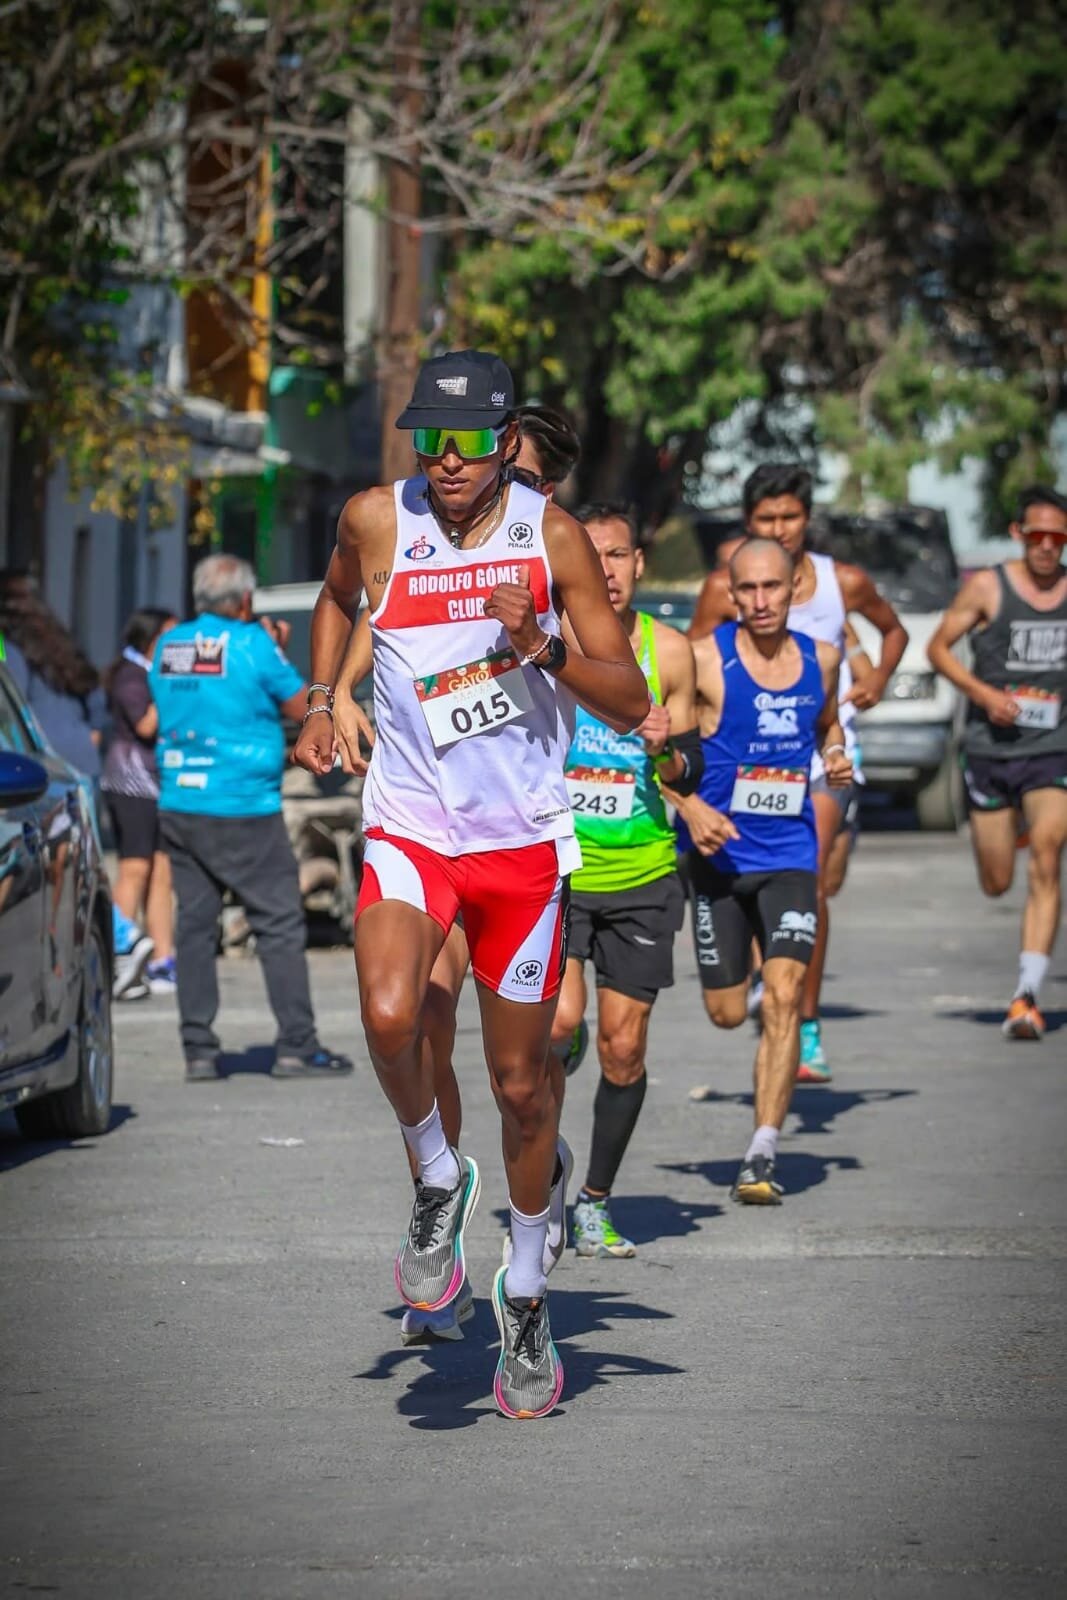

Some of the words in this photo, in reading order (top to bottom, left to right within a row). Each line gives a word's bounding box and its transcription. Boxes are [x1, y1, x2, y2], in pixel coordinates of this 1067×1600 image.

[408, 572, 473, 596] RODOLFO
[476, 564, 521, 587] GÓME
[448, 597, 486, 619] CLUB
[451, 691, 510, 734] 015
[571, 792, 617, 814] 243
[747, 792, 788, 811] 048
